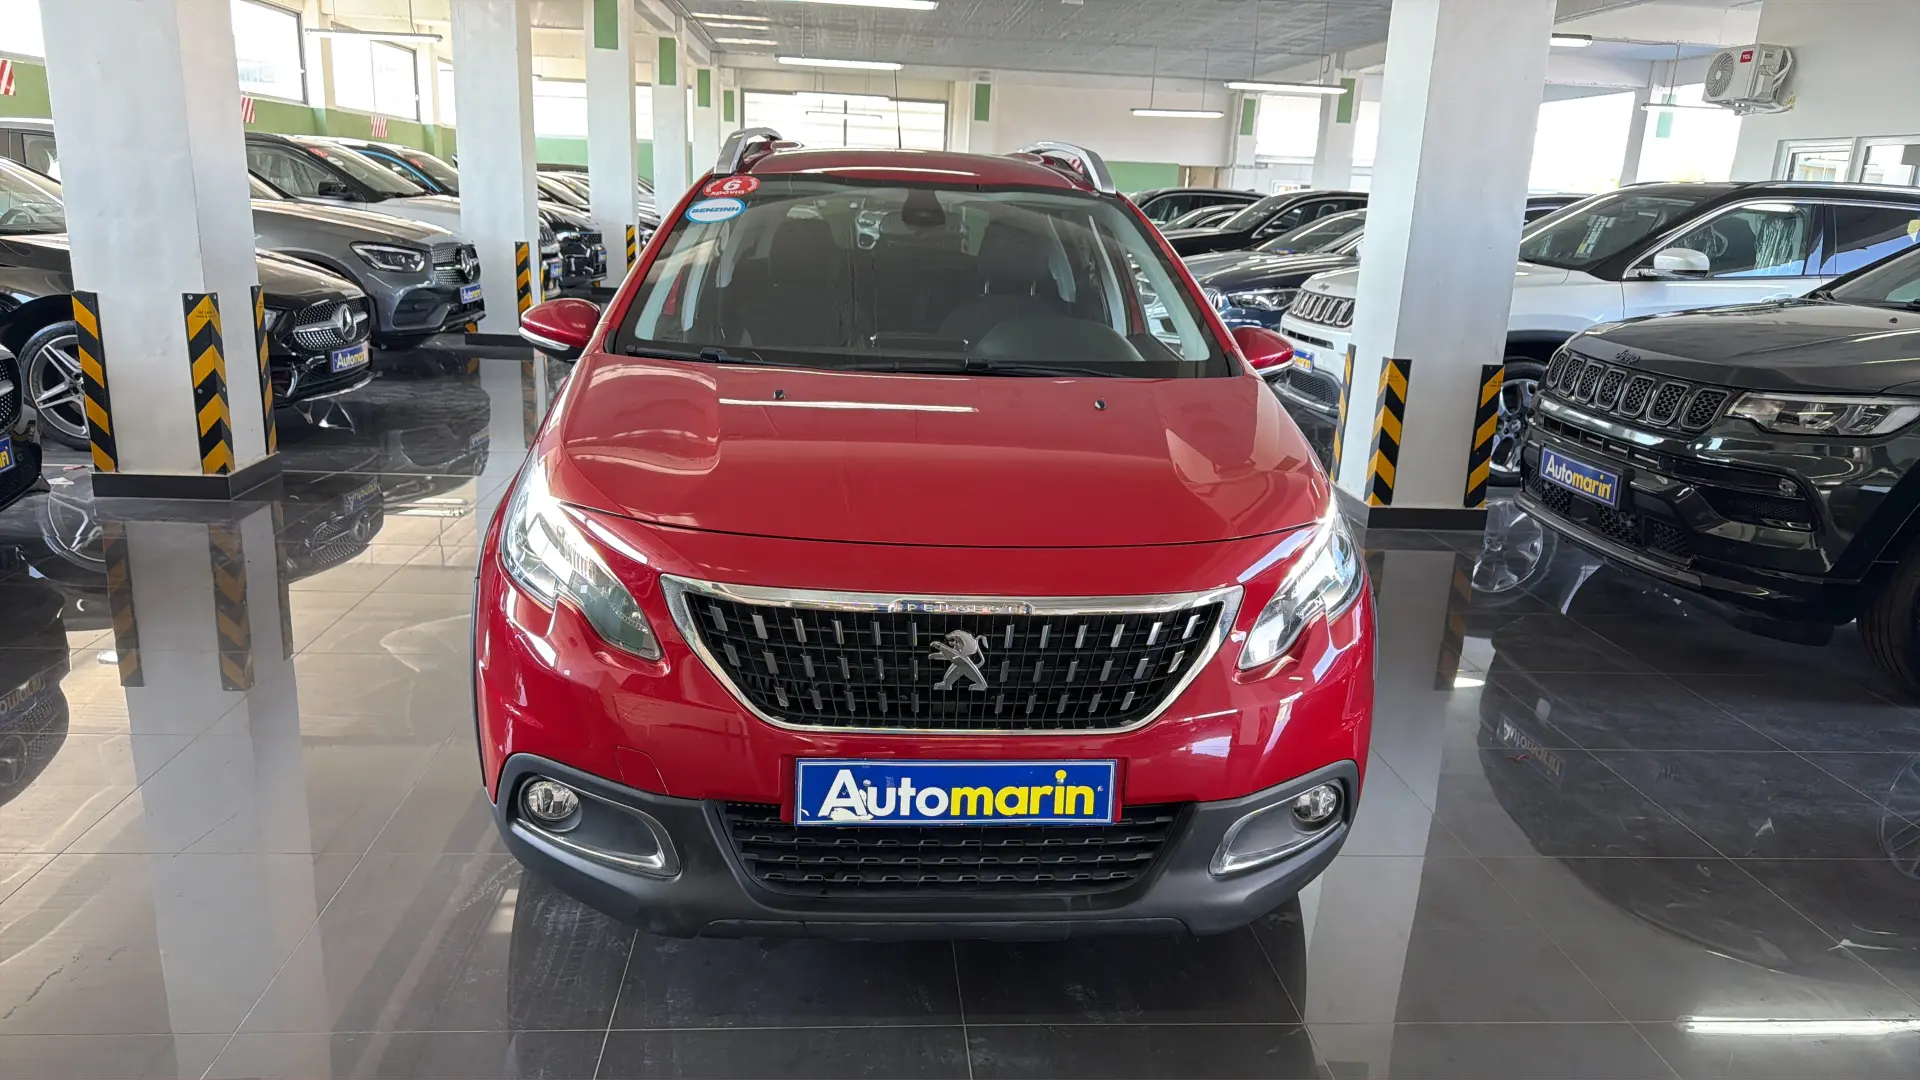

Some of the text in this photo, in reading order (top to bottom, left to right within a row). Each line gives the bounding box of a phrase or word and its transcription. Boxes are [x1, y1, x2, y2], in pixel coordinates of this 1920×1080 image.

[723, 179, 742, 190] 6
[1545, 454, 1612, 500] Automarin
[907, 602, 1013, 613] PEUGEOT
[817, 769, 1095, 818] Automarin
